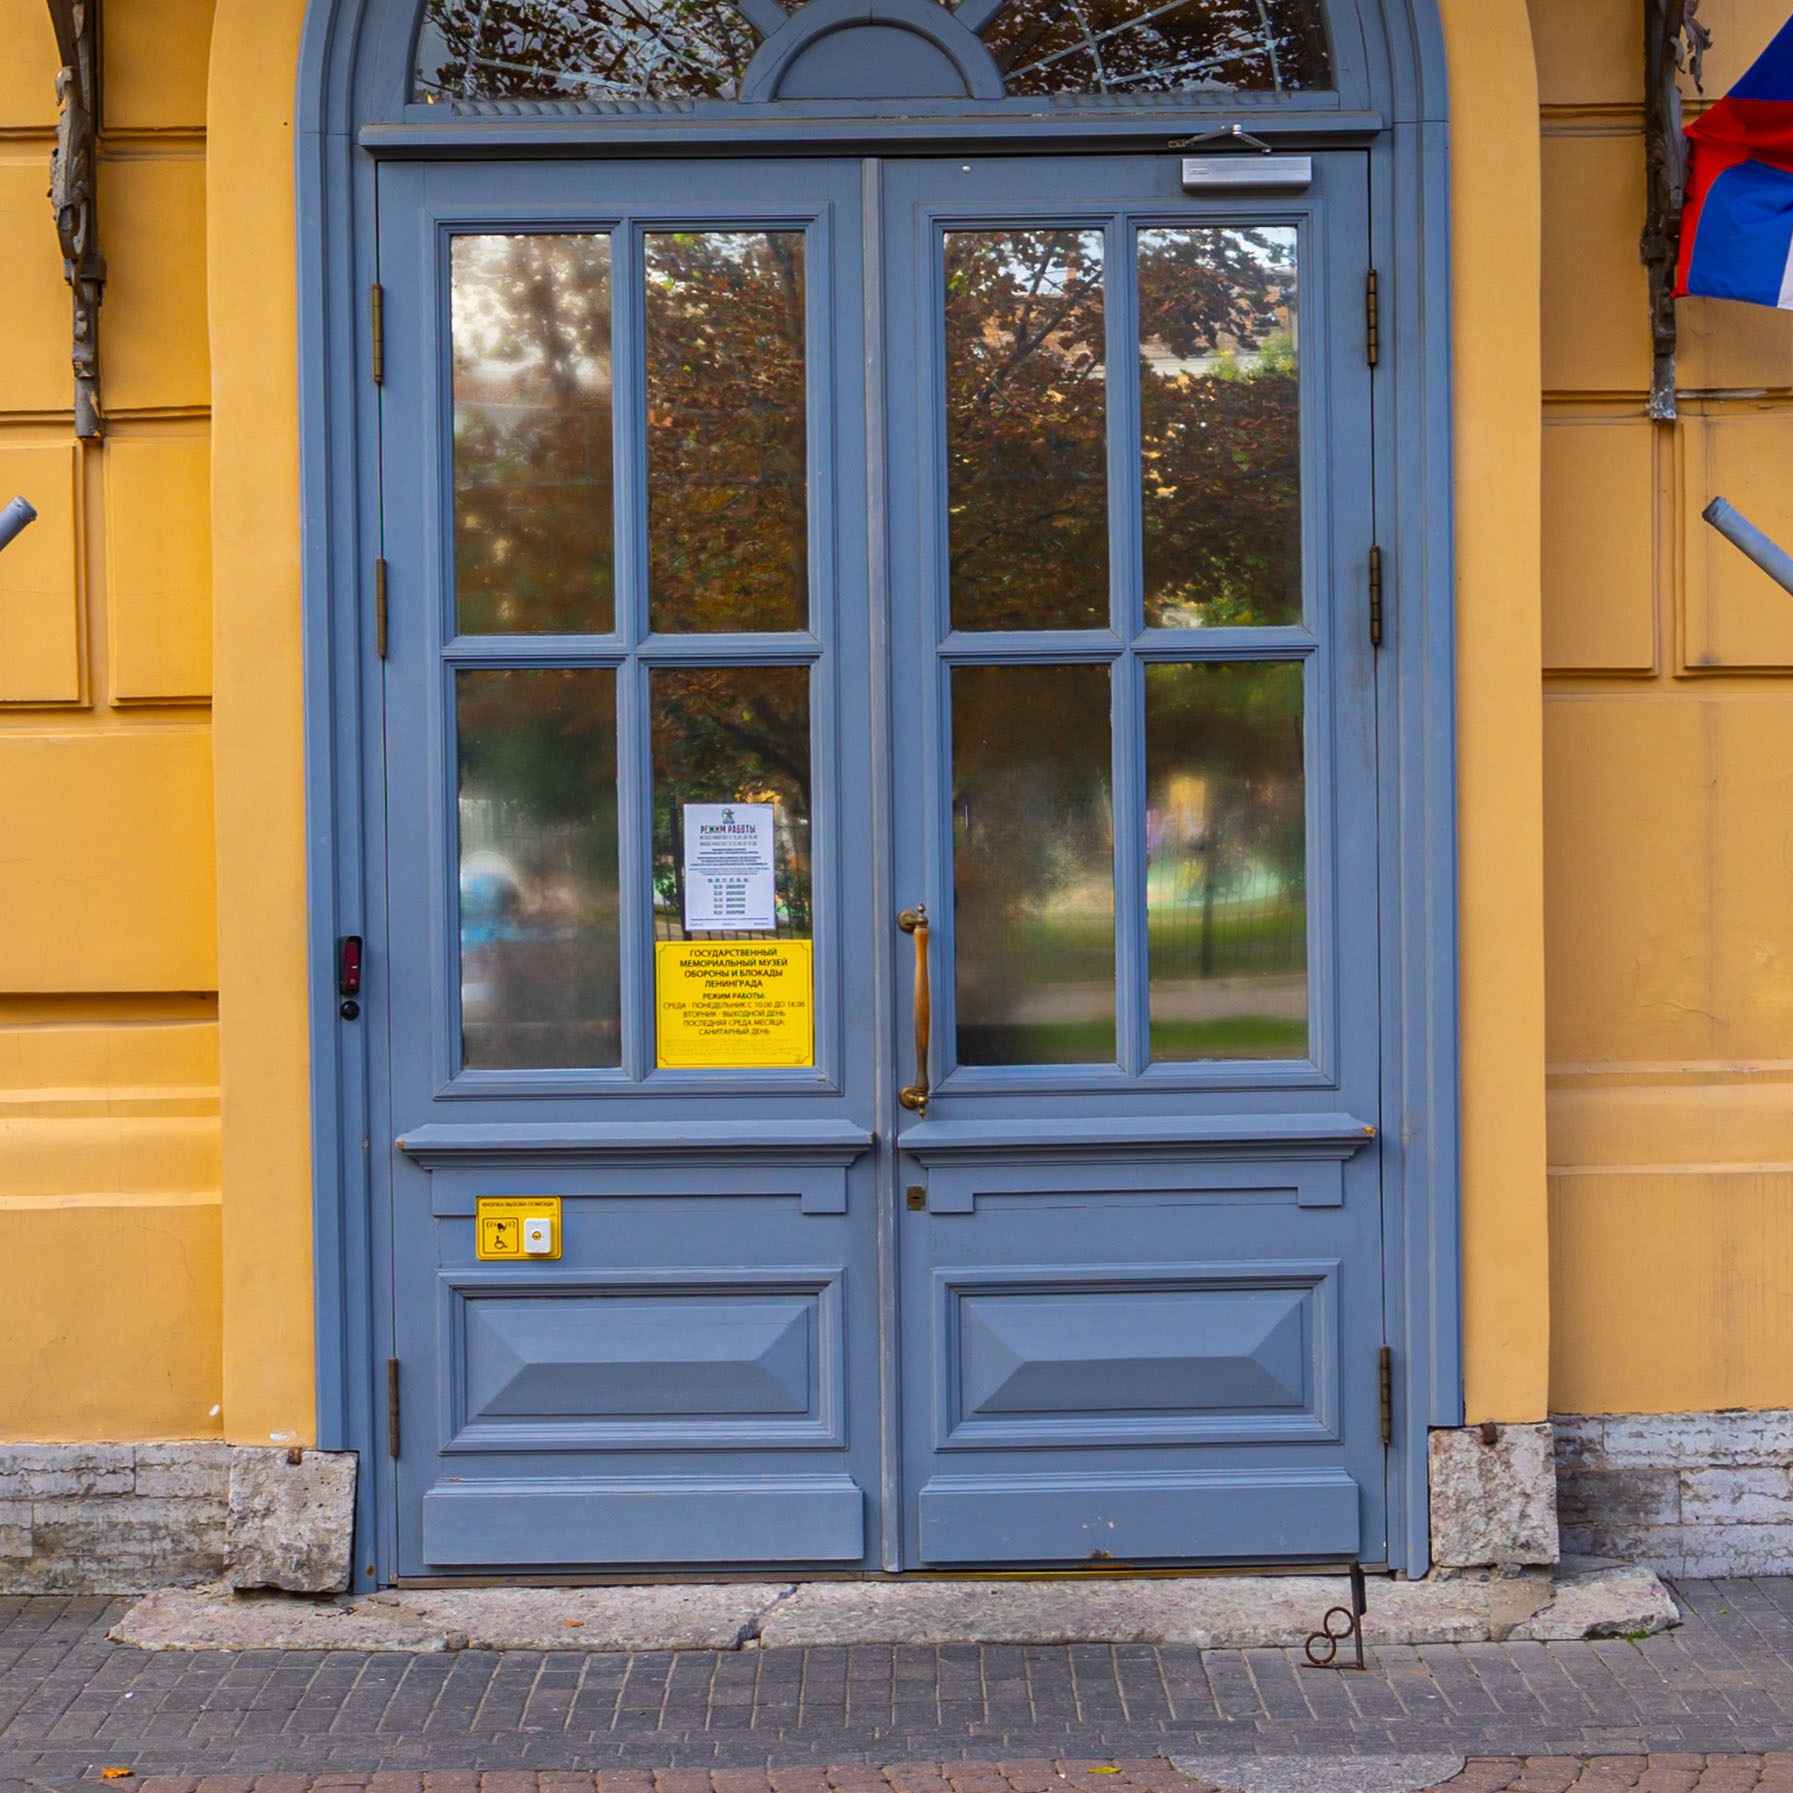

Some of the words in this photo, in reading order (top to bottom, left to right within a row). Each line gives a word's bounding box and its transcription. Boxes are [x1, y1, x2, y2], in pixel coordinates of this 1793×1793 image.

[700, 825, 726, 834] РЕЖИМ
[728, 824, 756, 834] РАБОТЫ
[690, 948, 778, 958] ГОСУДАРСТВЕННЫЙ
[680, 958, 757, 968] МЕМОРИАЛЬНЫЙ
[759, 957, 788, 967] МУЗЕЙ
[684, 969, 729, 978] ОБОРОНЫ
[731, 969, 738, 977] И
[739, 969, 784, 978] БЛОКАДЫ
[704, 979, 763, 988] ЛЕНИНГРАДА
[703, 992, 731, 1000] РЕЖИМ
[663, 1001, 687, 1010] СРЕДА
